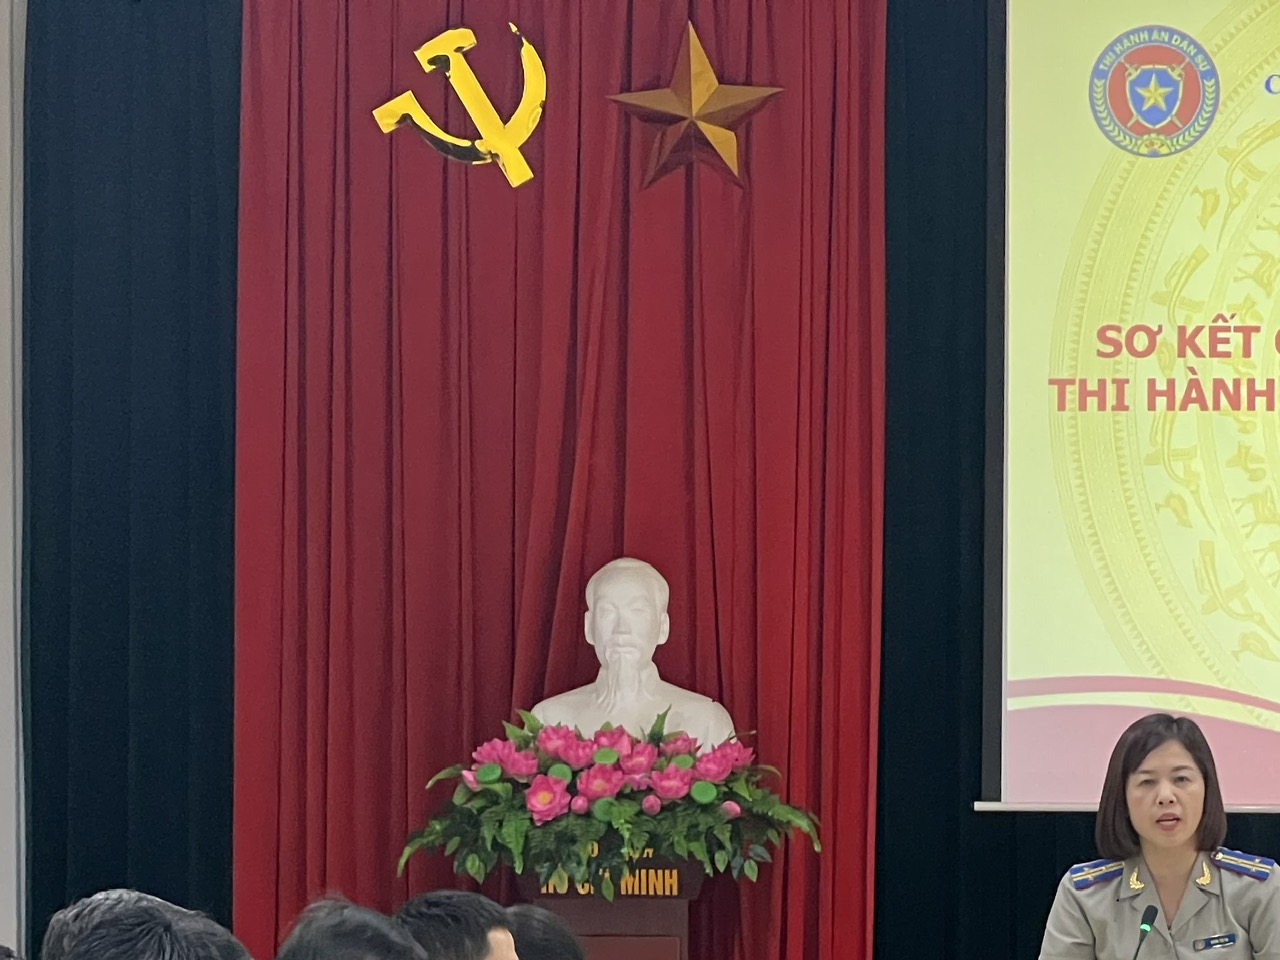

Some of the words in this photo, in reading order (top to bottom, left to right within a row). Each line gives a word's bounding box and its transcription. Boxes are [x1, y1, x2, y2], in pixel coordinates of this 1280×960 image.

[1096, 323, 1163, 359] SƠ
[1177, 313, 1261, 359] KẾT
[1049, 379, 1130, 412] THI
[1147, 367, 1276, 412] HÀNH
[620, 868, 678, 896] MINH
